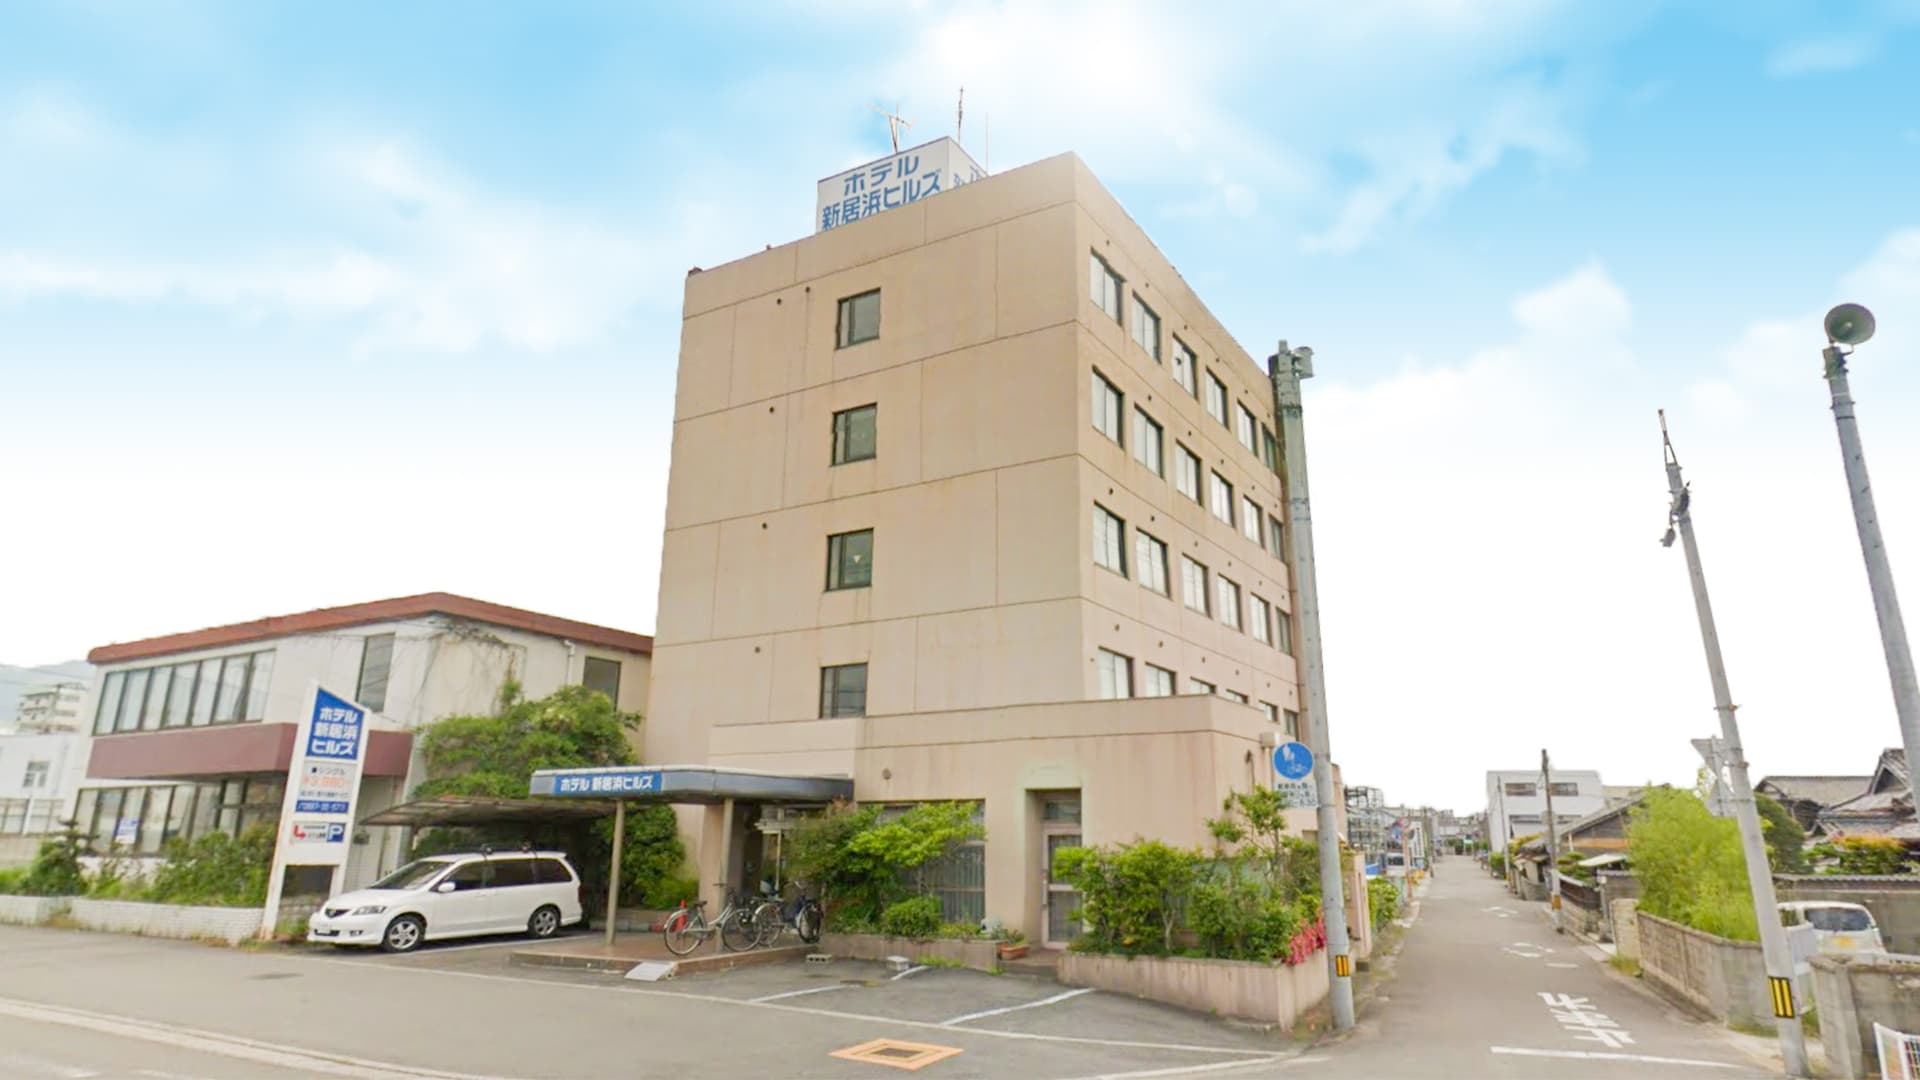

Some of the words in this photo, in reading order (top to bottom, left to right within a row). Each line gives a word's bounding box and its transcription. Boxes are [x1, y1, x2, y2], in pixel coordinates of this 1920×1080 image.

[844, 155, 920, 196] ホテル
[821, 167, 943, 230] 新居浜ヒルズ
[319, 707, 358, 723] ホテル
[560, 778, 590, 792] ホテル
[328, 825, 344, 841] P
